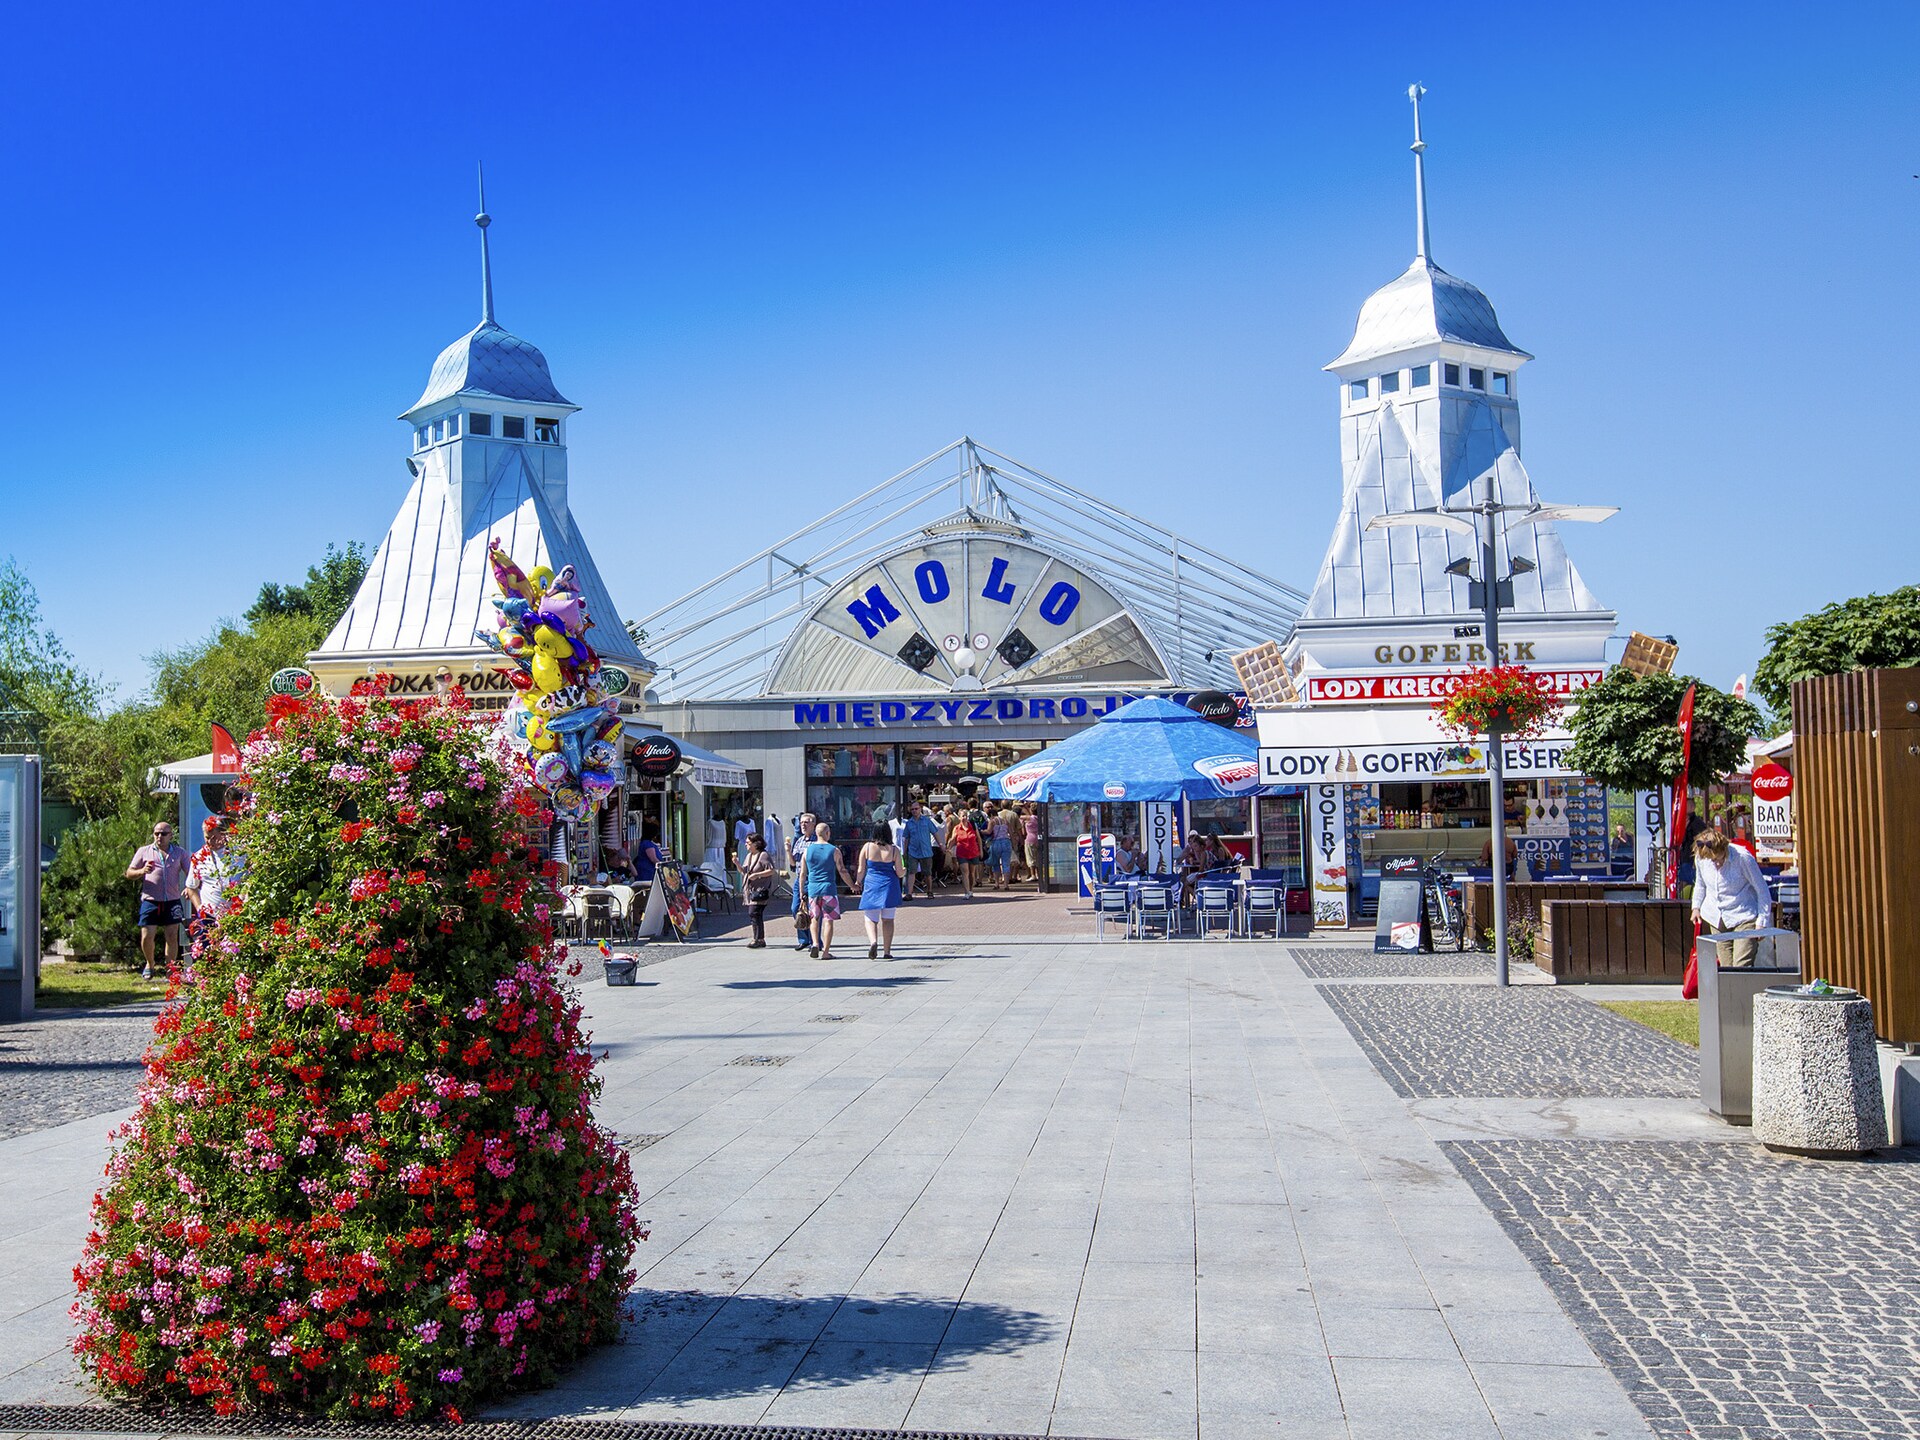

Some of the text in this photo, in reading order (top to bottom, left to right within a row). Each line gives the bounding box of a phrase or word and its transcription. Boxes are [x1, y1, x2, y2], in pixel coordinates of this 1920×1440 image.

[846, 557, 1081, 639] MOLO
[1375, 642, 1536, 664] GOFEREK
[1312, 673, 1601, 698] LODY KRĘCO OFRY
[634, 743, 671, 758] Alfredo
[1266, 748, 1572, 776] LODY GOFRY ESER
[1753, 776, 1789, 788] Coca-Cola
[1319, 785, 1336, 862] GOFRY
[1645, 789, 1660, 841] ODY
[1757, 806, 1786, 822] BAR
[1154, 803, 1166, 850] LODY
[1756, 824, 1789, 835] TOMATO
[1515, 839, 1563, 852] LODY
[1385, 857, 1415, 871] Alfredo
